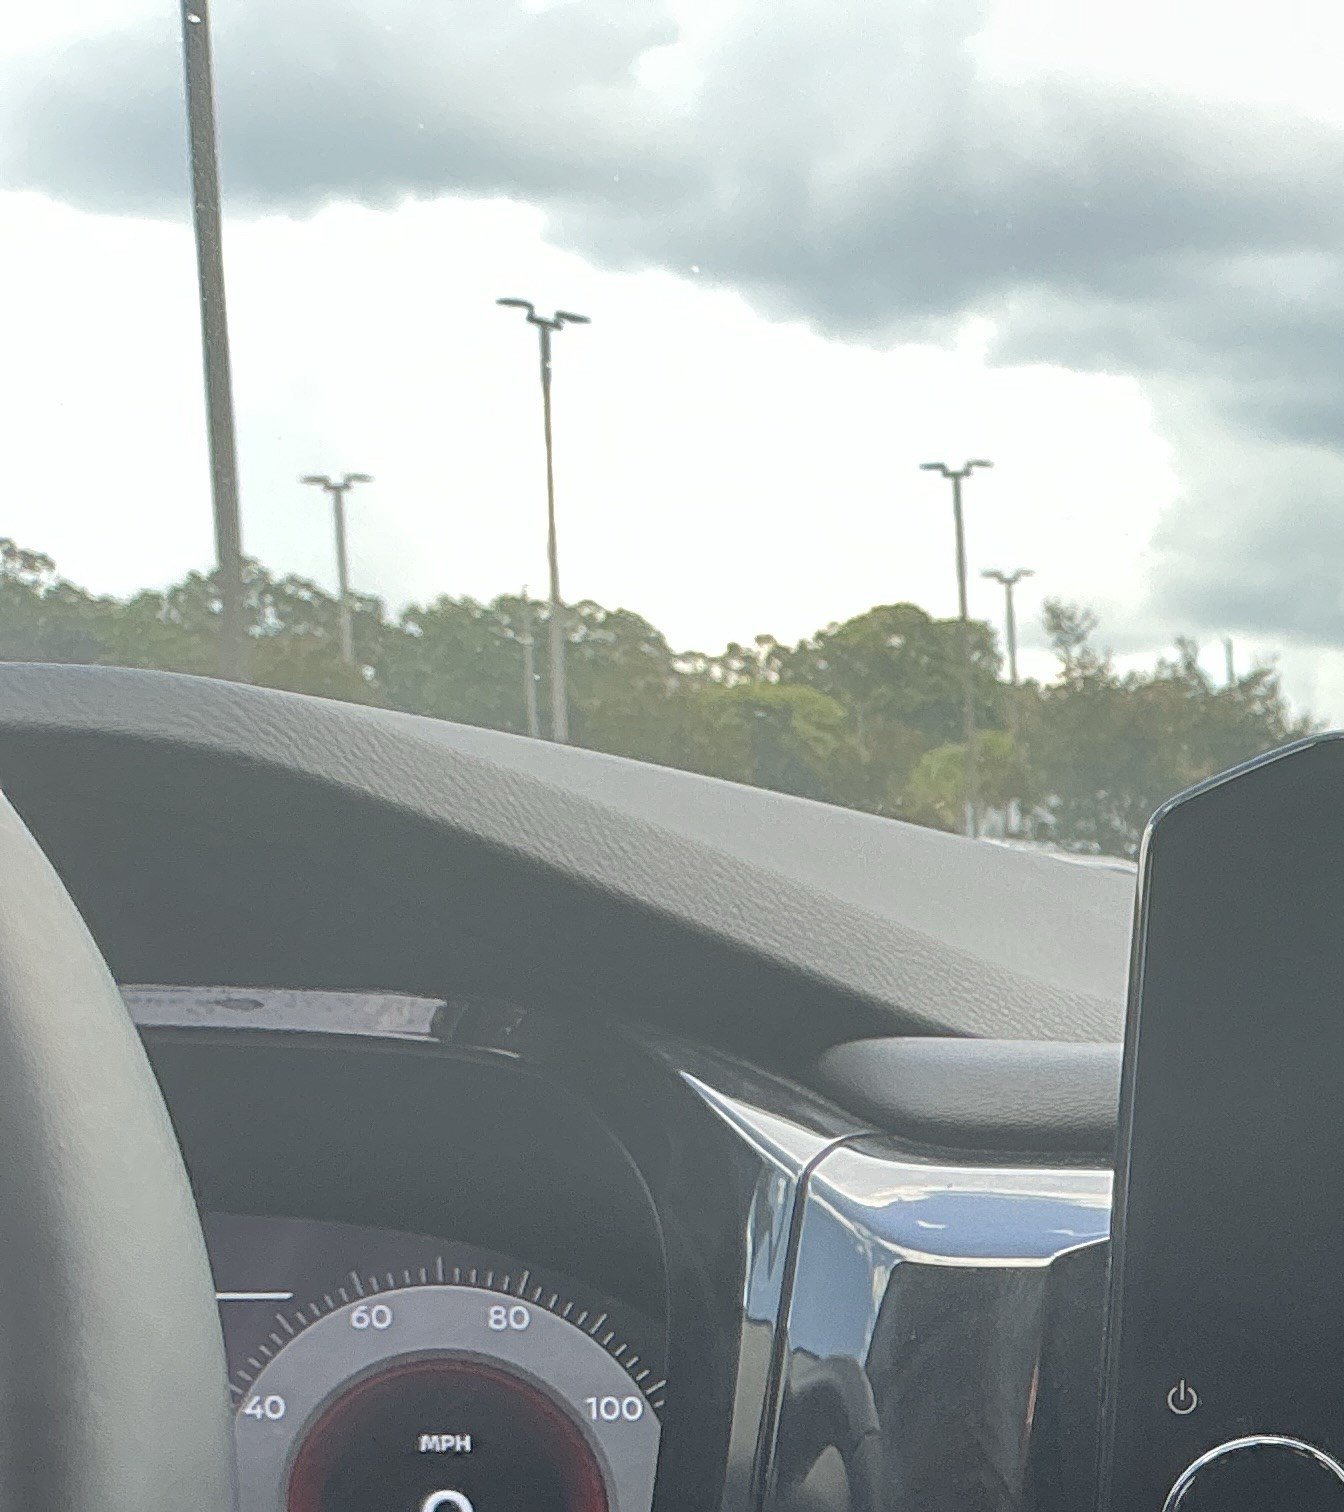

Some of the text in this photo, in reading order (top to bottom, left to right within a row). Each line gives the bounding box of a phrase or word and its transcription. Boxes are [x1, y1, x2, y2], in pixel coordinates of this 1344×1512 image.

[350, 1303, 393, 1330] 60
[487, 1303, 531, 1331] 80
[243, 1395, 286, 1421] 40
[585, 1396, 645, 1422] 100
[418, 1433, 472, 1454] MPH
